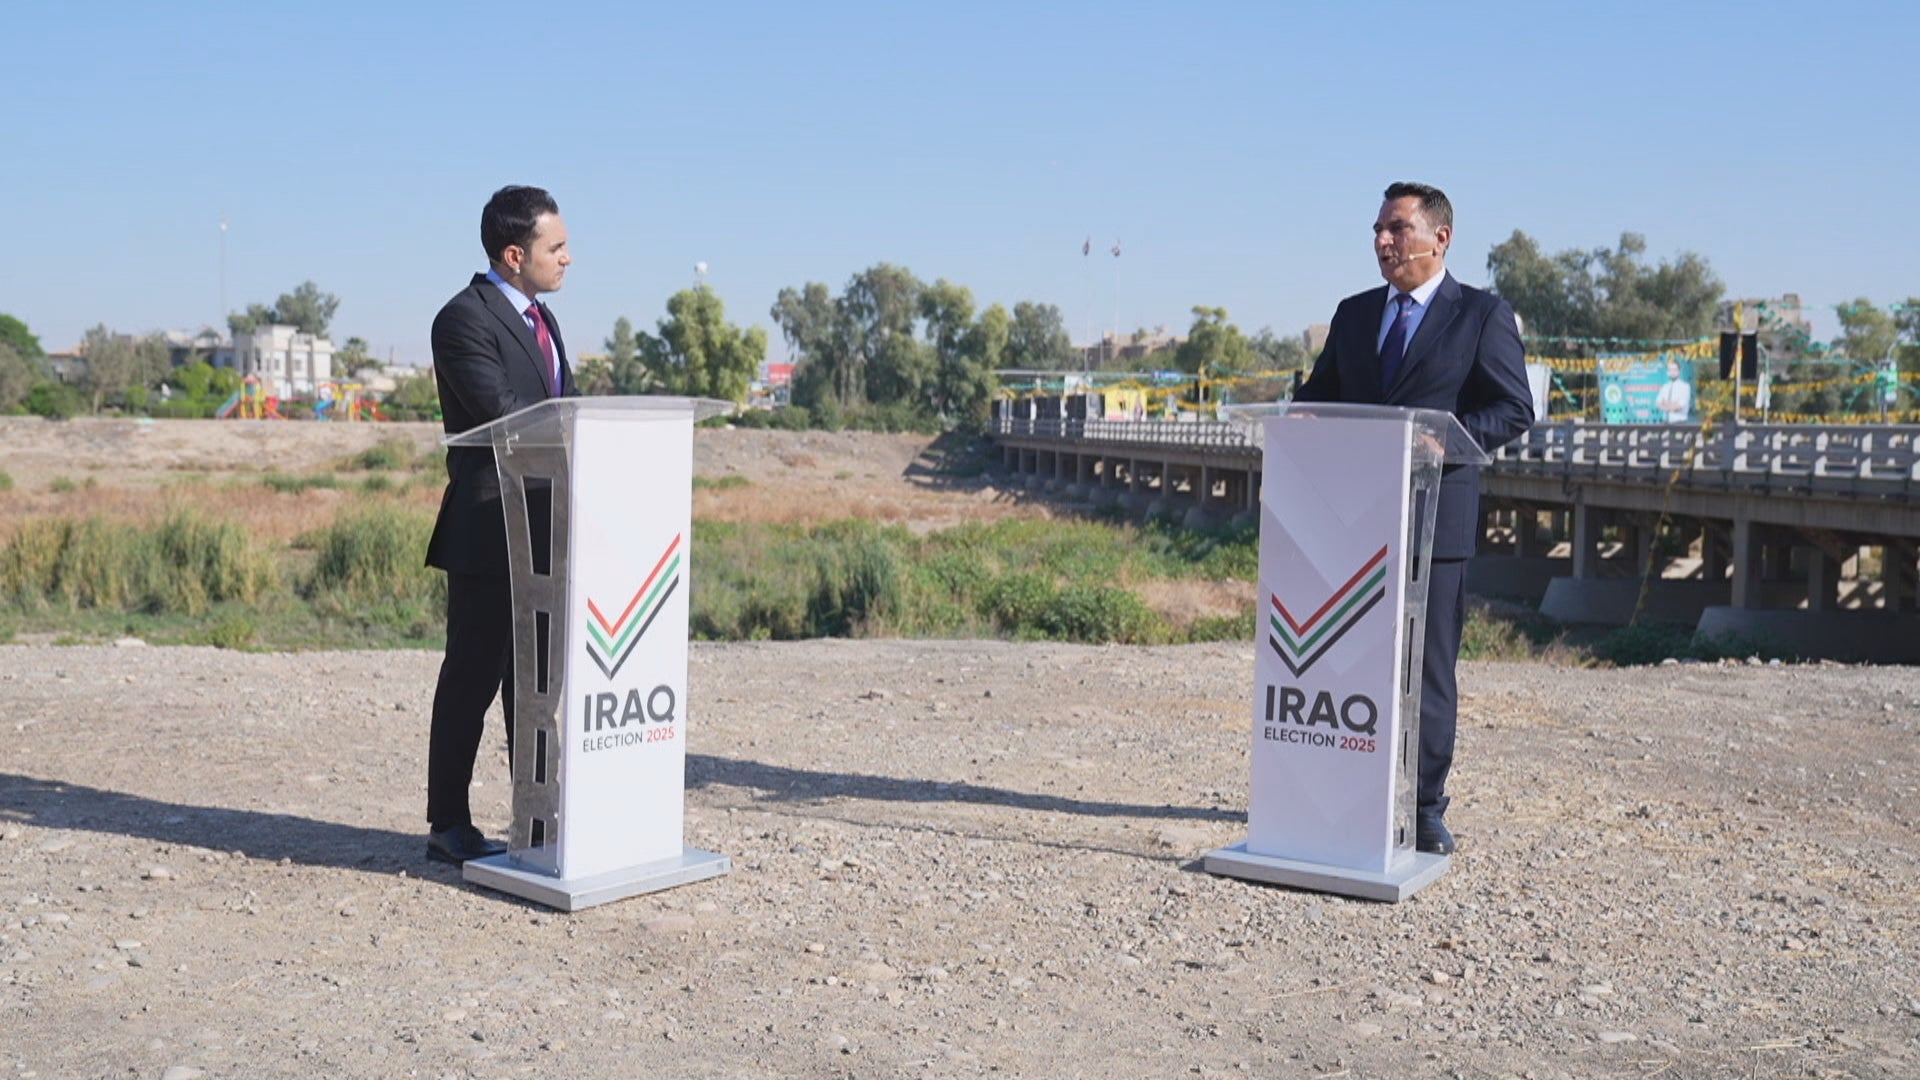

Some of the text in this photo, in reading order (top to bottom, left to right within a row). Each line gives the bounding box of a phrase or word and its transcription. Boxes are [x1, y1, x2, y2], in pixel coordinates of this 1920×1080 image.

[584, 685, 675, 732] IRAQ
[1265, 685, 1378, 736] IRAQ
[583, 726, 675, 753] ELECTION 2025
[1264, 726, 1376, 753] ELECTION 2025
